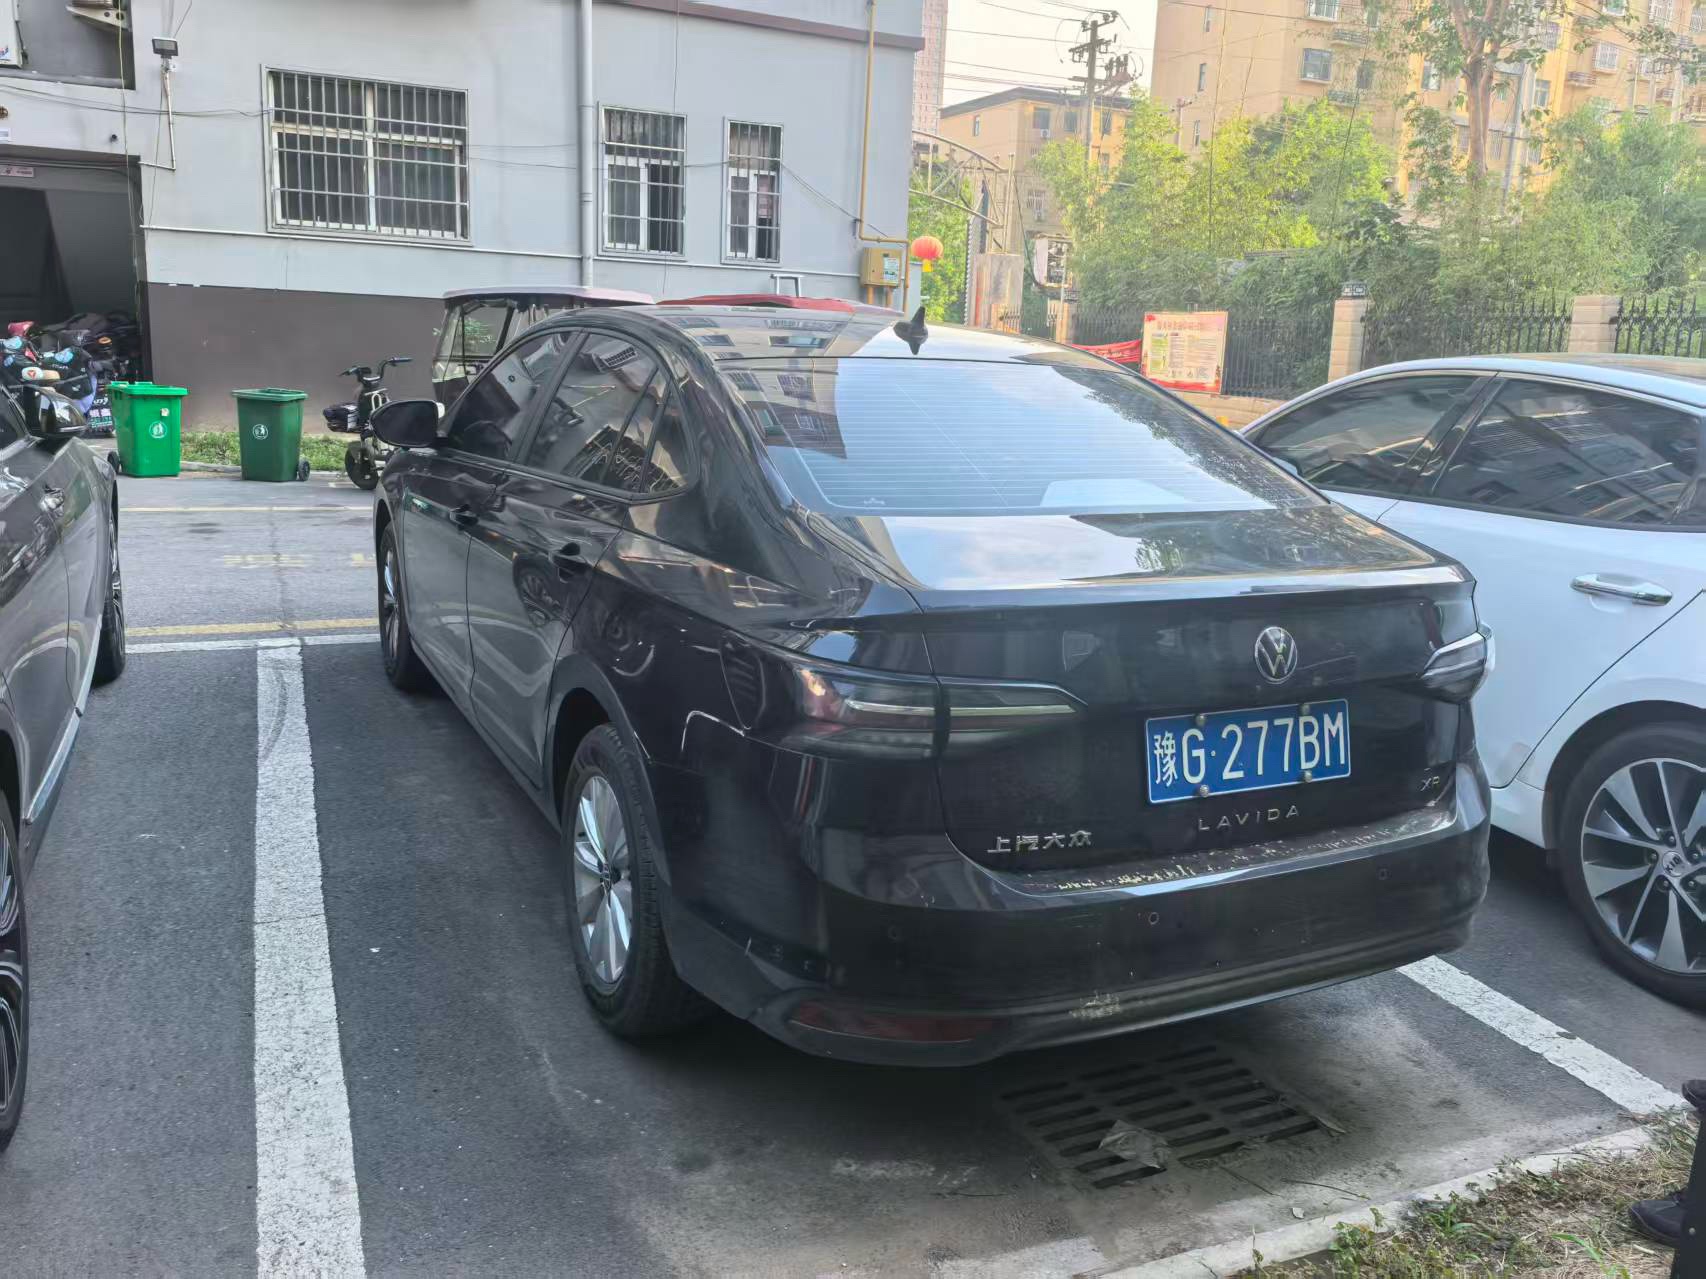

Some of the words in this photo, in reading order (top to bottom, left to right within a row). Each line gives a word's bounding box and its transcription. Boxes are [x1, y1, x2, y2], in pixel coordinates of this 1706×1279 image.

[1152, 711, 1346, 788] 豫G·277BM
[1199, 805, 1299, 830] LAVIDA
[986, 829, 1092, 853] 上汽大众
